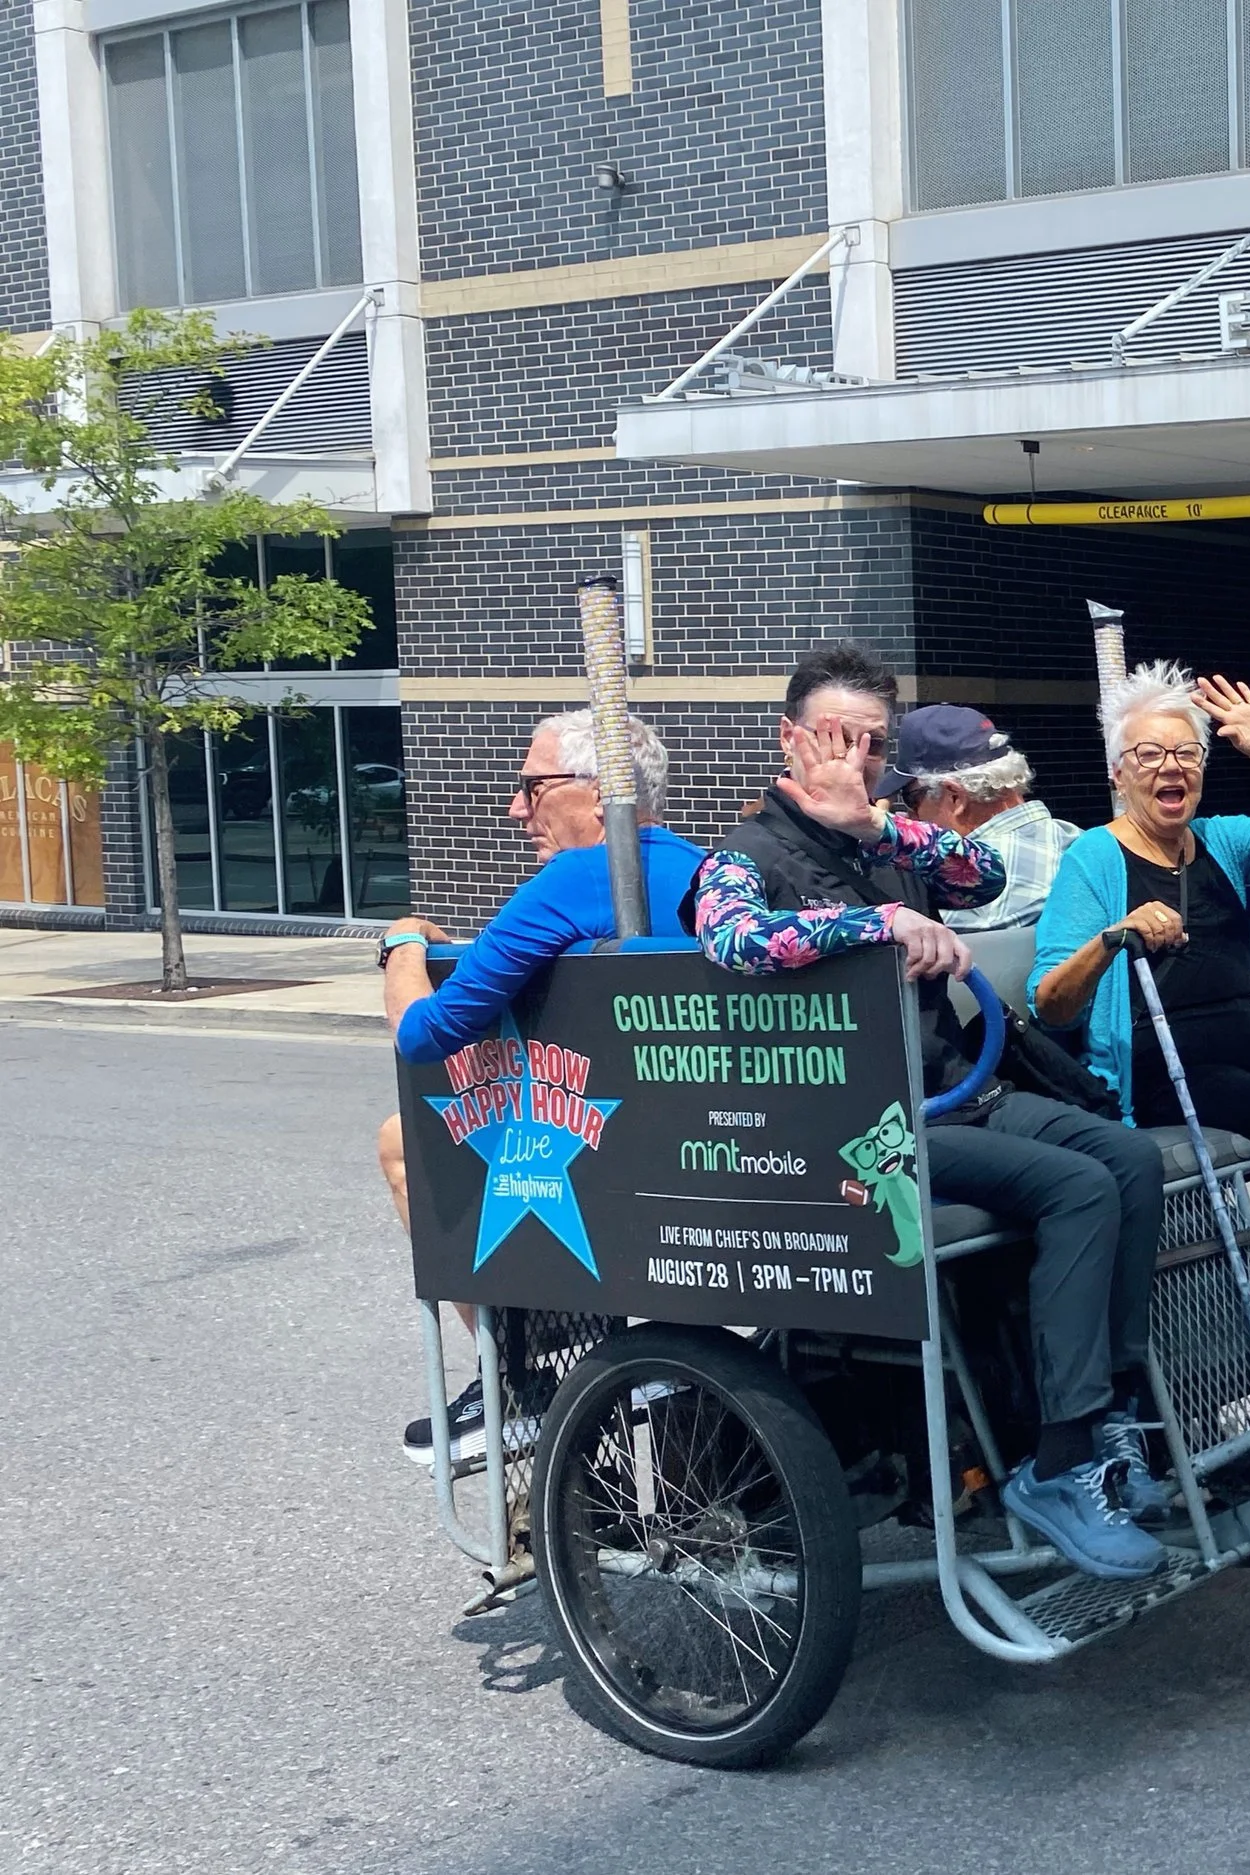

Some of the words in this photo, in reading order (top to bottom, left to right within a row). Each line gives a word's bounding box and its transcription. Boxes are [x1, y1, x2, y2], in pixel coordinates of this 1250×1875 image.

[1098, 505, 1168, 519] CLEARANCE
[1186, 503, 1202, 517] 10'
[0, 811, 56, 822] MEICAN
[1, 827, 55, 839] CUINE
[613, 994, 721, 1032] COLLEGE
[726, 993, 858, 1032] FOOTBALL
[444, 1037, 524, 1095] MUSIC
[527, 1039, 591, 1096] ROW
[633, 1045, 733, 1083] KICKOFF
[740, 1046, 846, 1085] EDITION
[443, 1081, 523, 1146] HAPPY
[530, 1082, 605, 1151] HOUR
[708, 1110, 753, 1127] PRESENTED
[754, 1112, 766, 1127] BY
[500, 1127, 552, 1164] Live
[509, 1172, 562, 1204] highway
[660, 1225, 681, 1245] LIVE
[683, 1227, 713, 1247] FROM
[715, 1229, 760, 1249] CHIEF'S
[763, 1231, 782, 1249] ON
[784, 1232, 849, 1253] BROADWAY
[648, 1257, 703, 1287] AUGUST
[706, 1262, 729, 1288] 28
[852, 1269, 873, 1295] CT
